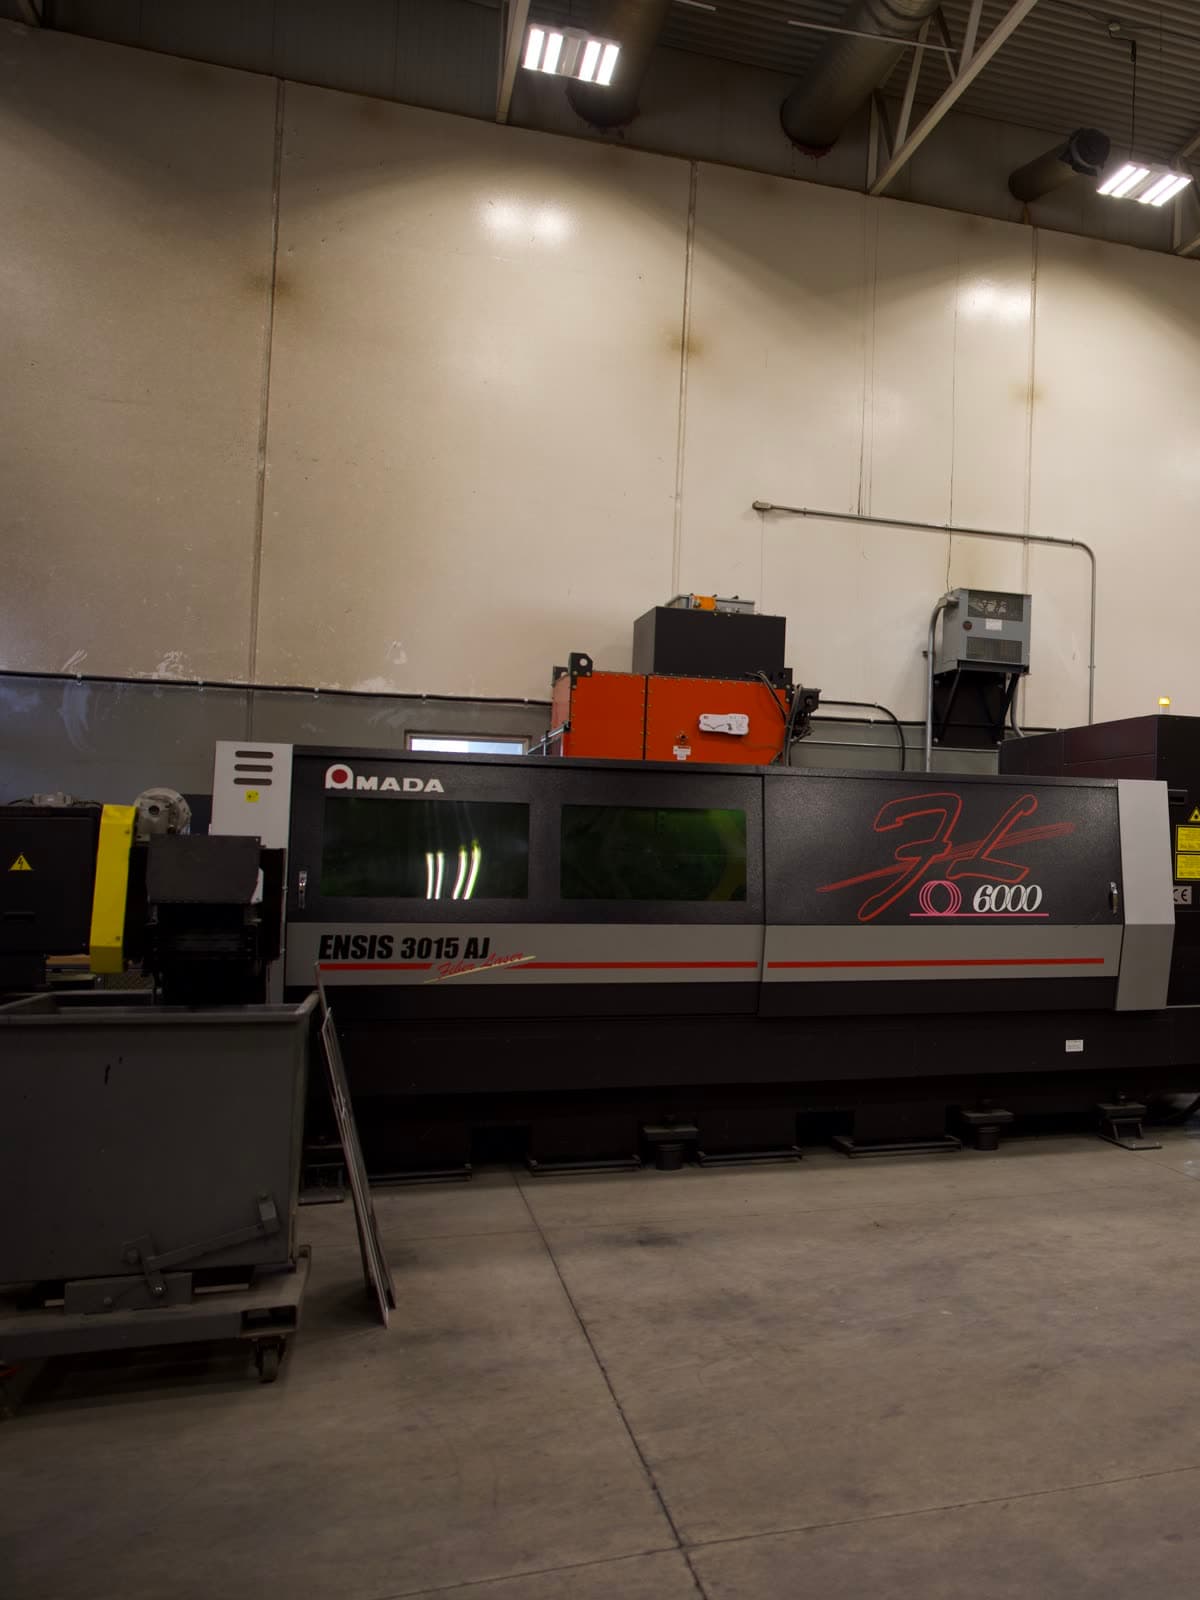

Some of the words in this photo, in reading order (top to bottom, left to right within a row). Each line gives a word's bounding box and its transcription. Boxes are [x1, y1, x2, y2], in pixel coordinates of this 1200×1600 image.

[324, 763, 445, 793] AMADA
[972, 884, 1043, 912] 6000
[319, 935, 394, 960] ENSIS
[401, 937, 459, 960] 3015
[464, 937, 490, 960] AJ
[436, 960, 475, 977] Fiber
[481, 951, 524, 967] Laser
